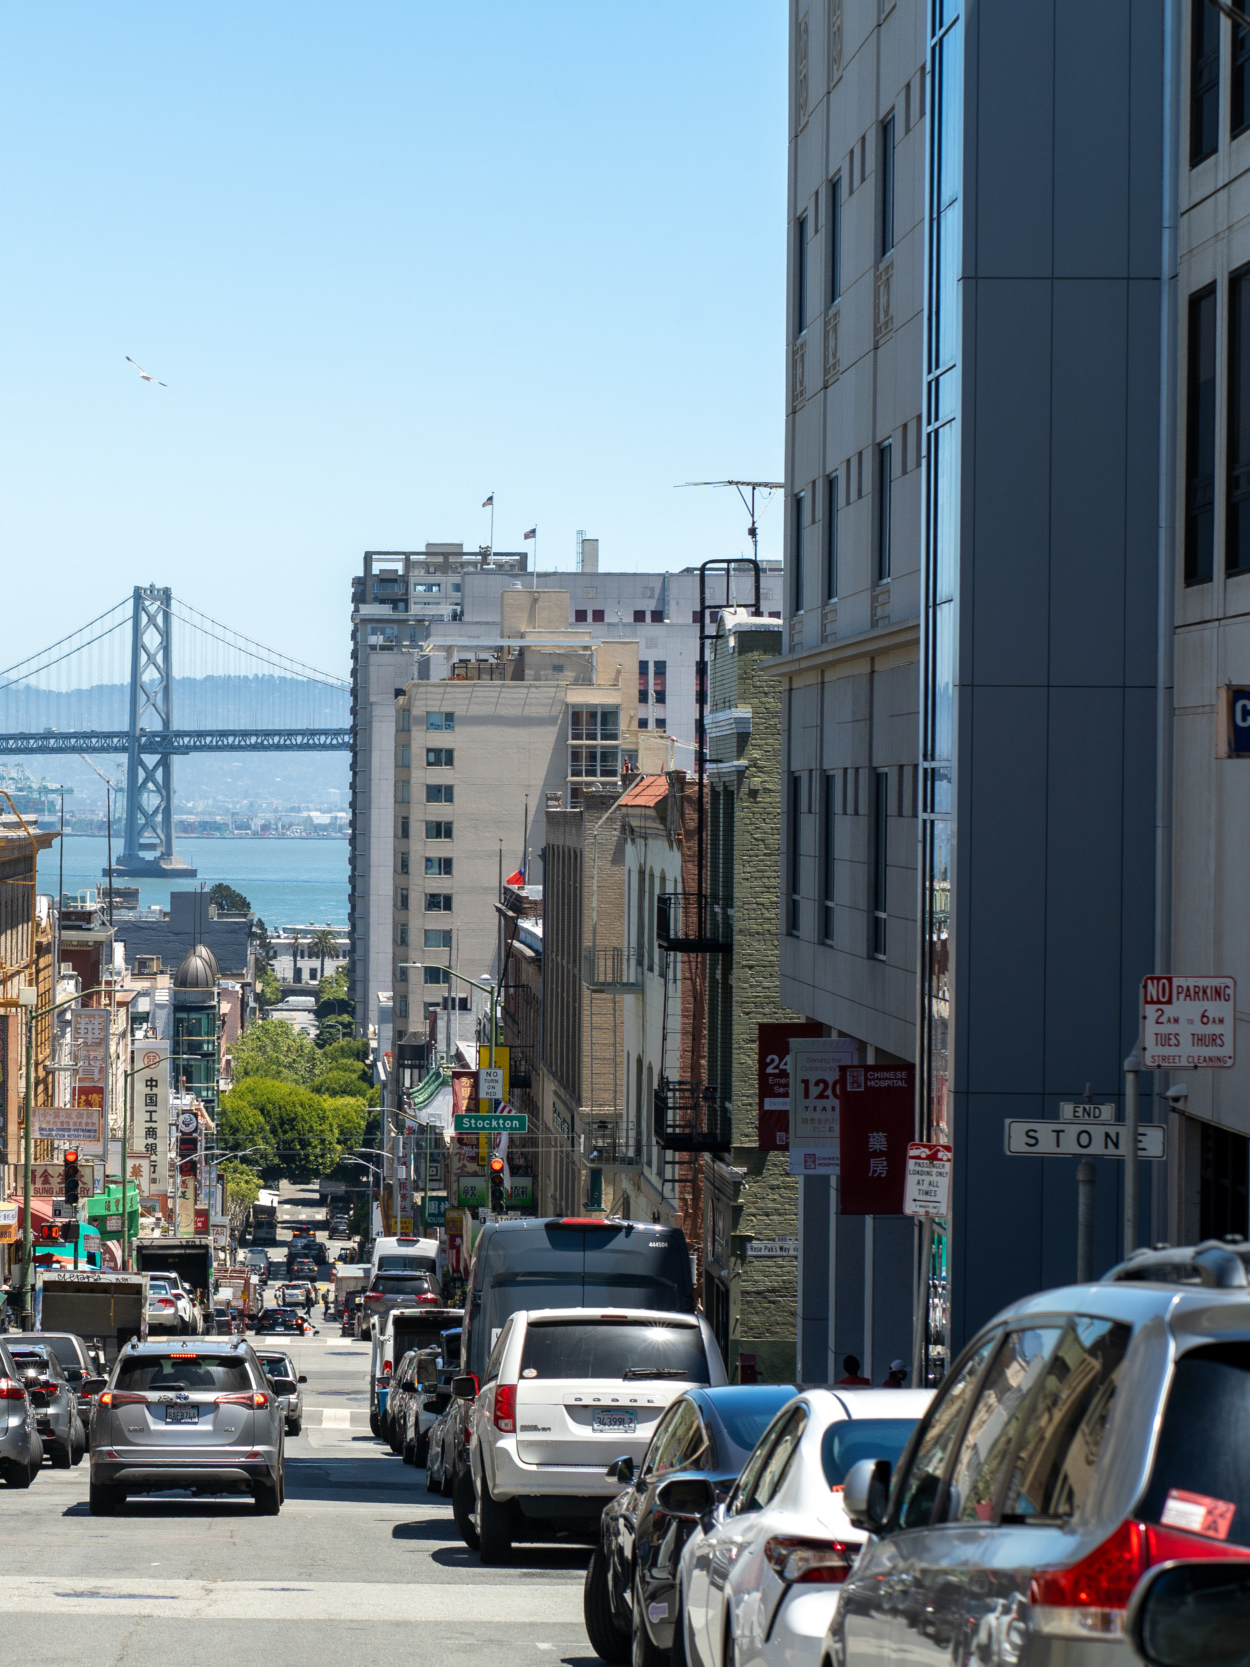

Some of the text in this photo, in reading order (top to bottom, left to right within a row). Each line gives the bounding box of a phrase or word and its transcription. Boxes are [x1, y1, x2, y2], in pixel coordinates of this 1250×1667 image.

[1147, 980, 1230, 1002] NO PARKING
[1154, 1008, 1180, 1024] 2AM
[1200, 1008, 1224, 1026] 6AM
[1154, 1032, 1225, 1048] TUES THURS
[806, 1056, 830, 1065] Serving
[1150, 1054, 1182, 1064] STREET
[768, 1077, 790, 1085] Emer
[1072, 1106, 1102, 1119] END
[462, 1118, 520, 1128] Stockton
[1024, 1128, 1148, 1152] STONE
[868, 1132, 888, 1178] 藥房
[914, 1161, 946, 1170] PASSENGER
[909, 1169, 933, 1177] LOADING
[34, 1186, 54, 1195] SUNG
[56, 1186, 90, 1195] JERY
[918, 1189, 938, 1197] TIMES
[779, 1246, 790, 1254] Way
